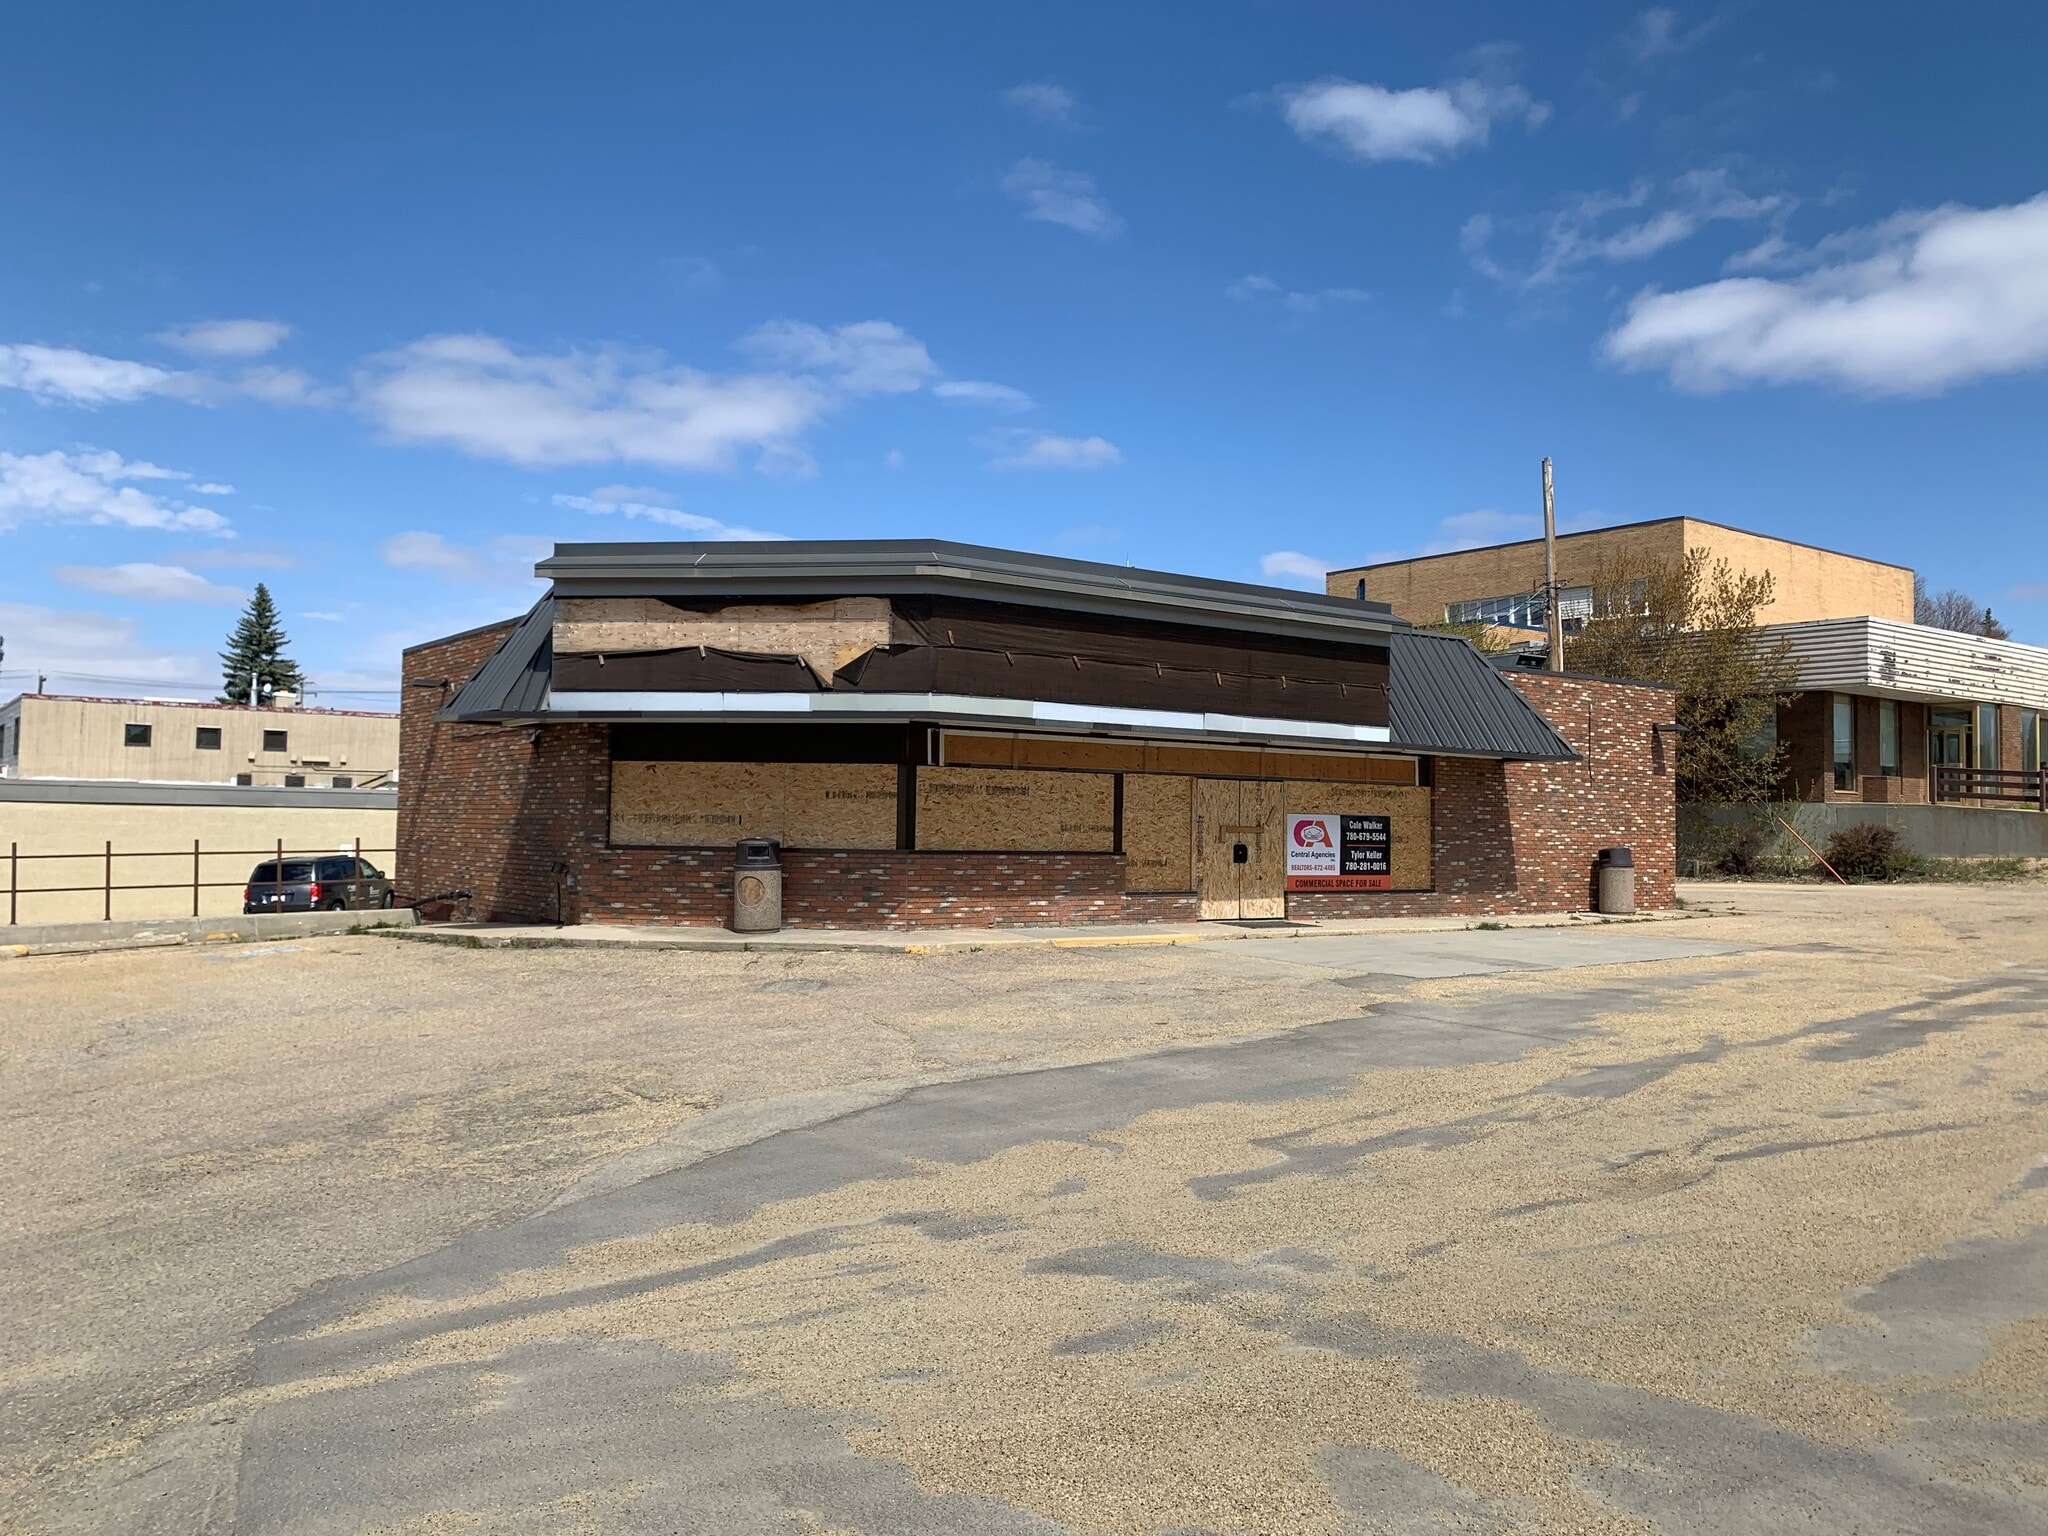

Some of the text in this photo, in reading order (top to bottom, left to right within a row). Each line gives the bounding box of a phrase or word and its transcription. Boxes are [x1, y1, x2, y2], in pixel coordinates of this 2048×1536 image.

[1349, 820, 1383, 830] Cole Walker
[1346, 832, 1386, 841] 780-679-5544
[1290, 850, 1336, 860] Central Agencies
[1366, 850, 1383, 859] Keller
[1345, 862, 1387, 871] 780-281-0016
[1295, 879, 1382, 888] COMMERCIAL SPACE FOR SALE
